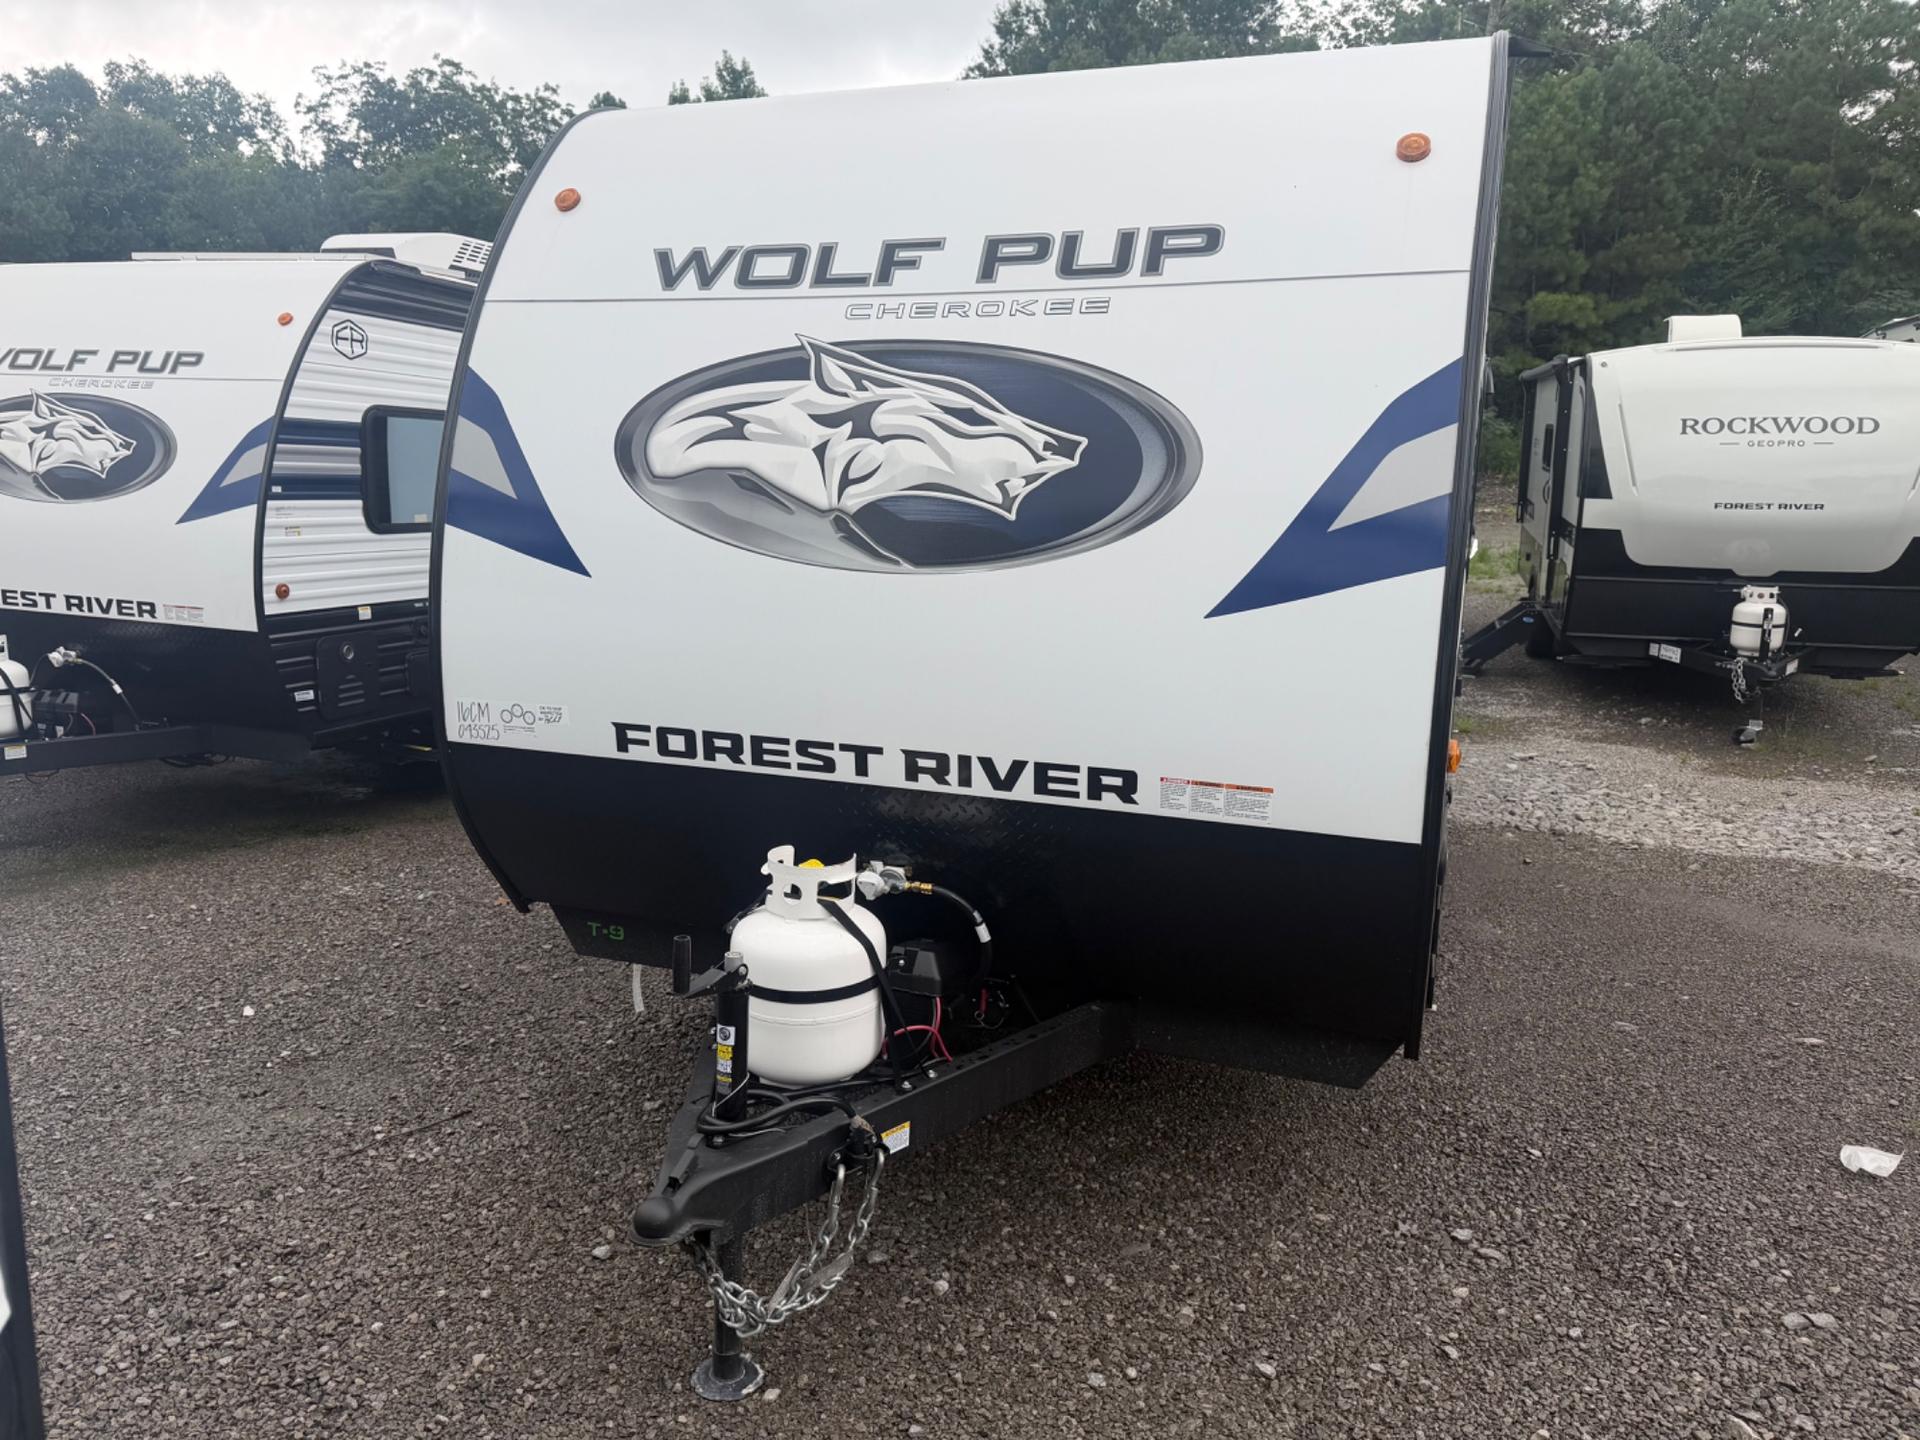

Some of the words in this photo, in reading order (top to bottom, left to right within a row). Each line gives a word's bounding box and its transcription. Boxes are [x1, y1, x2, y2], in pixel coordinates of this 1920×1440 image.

[653, 237, 947, 291] WOLF
[976, 223, 1226, 285] PUP
[845, 296, 1112, 321] CHEROKEE
[105, 349, 205, 375] PUP
[48, 377, 155, 390] CHEROKEE
[1679, 416, 1881, 435] ROCKWOOD
[1746, 439, 1806, 448] GEOPRO
[1714, 502, 1775, 510] FOREST
[1777, 502, 1825, 511] RIVER
[63, 594, 158, 619] RIVER
[610, 721, 884, 778] FOREST
[899, 748, 1140, 806] RIVER
